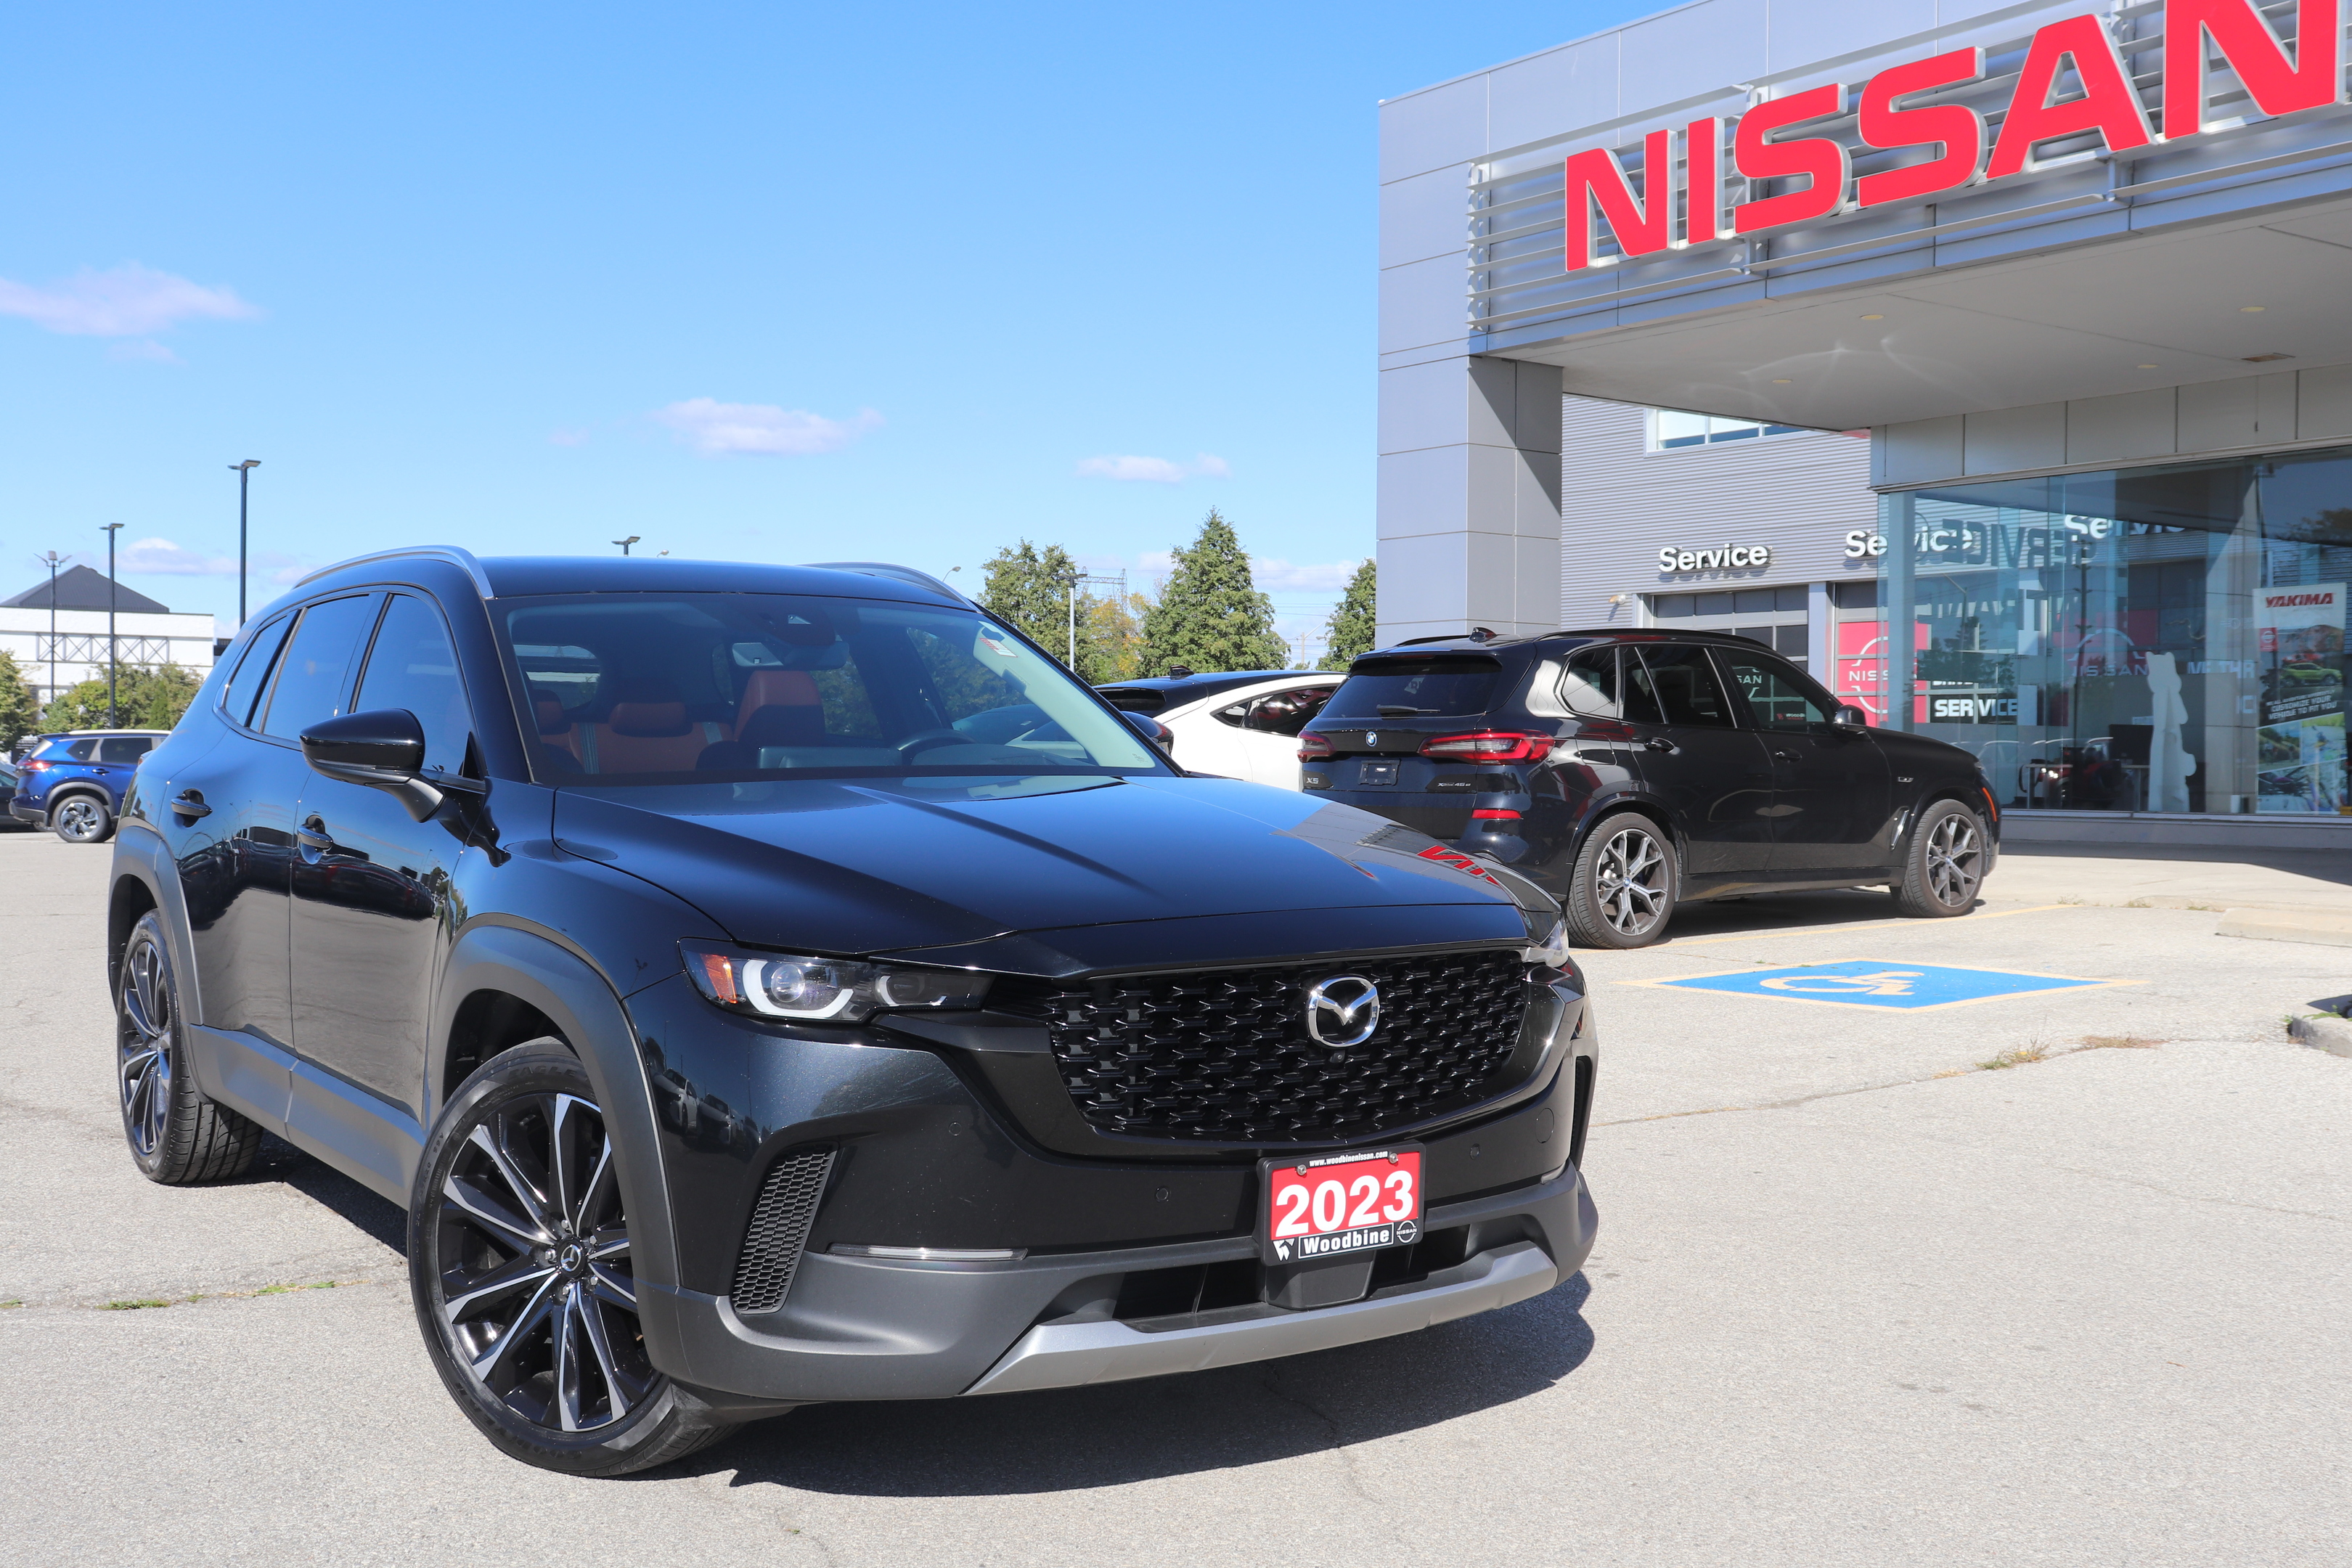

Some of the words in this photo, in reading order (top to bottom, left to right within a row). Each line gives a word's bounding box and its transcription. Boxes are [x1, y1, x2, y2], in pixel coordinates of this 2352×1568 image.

[1565, 0, 2343, 272] NISSAN
[1658, 543, 1769, 572] Service
[2265, 592, 2334, 608] YAKIMA
[1934, 698, 2017, 717] SERVICE
[2269, 709, 2296, 720] VEHICLE
[2321, 701, 2337, 711] YOU
[2271, 699, 2310, 711] CUSTOMIZE
[2311, 695, 2332, 705] YOUR
[1309, 1151, 1388, 1167] www.woodbinenissan.com
[1275, 1170, 1413, 1237] 2023
[1304, 1228, 1390, 1254] Woodbine
[1396, 1227, 1418, 1236] NISSAN
